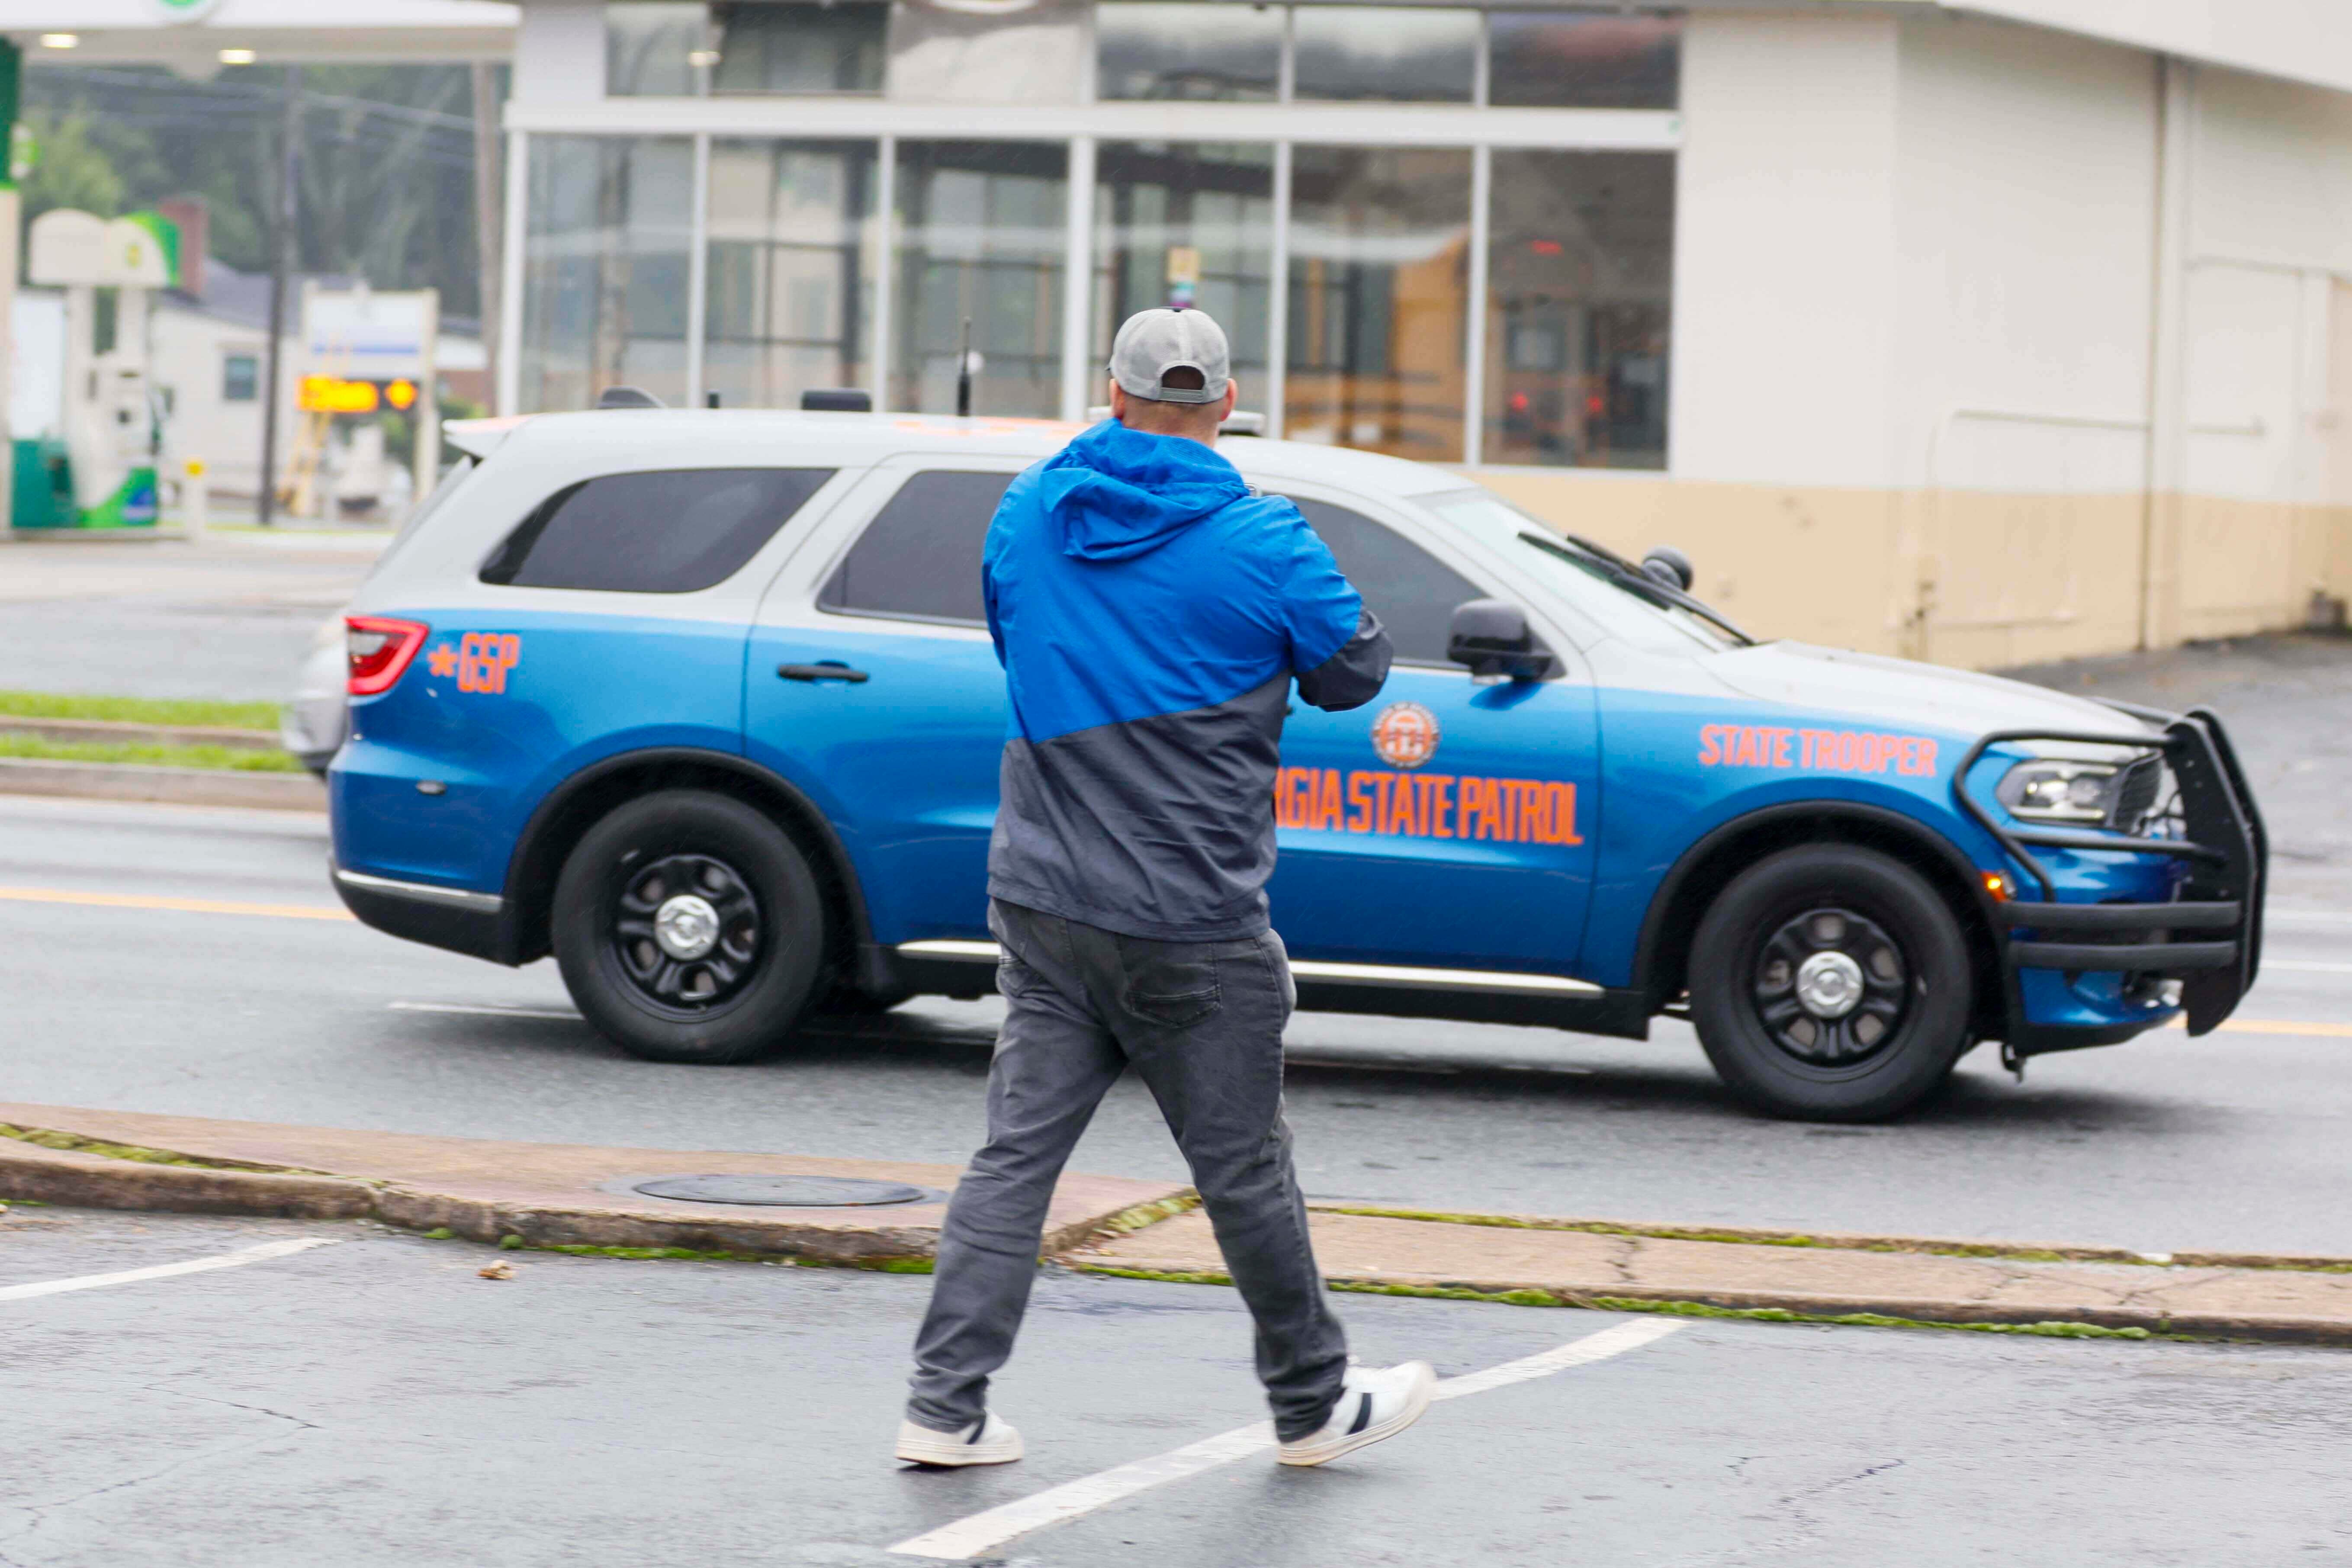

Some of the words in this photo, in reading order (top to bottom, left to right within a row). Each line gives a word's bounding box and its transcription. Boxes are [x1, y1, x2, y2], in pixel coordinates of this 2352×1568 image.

[457, 632, 521, 695] GSP
[1698, 724, 1794, 768] STATE
[1798, 729, 1938, 777] TROOPER
[1347, 771, 1455, 838] STATE
[1457, 775, 1584, 847] PATROL
